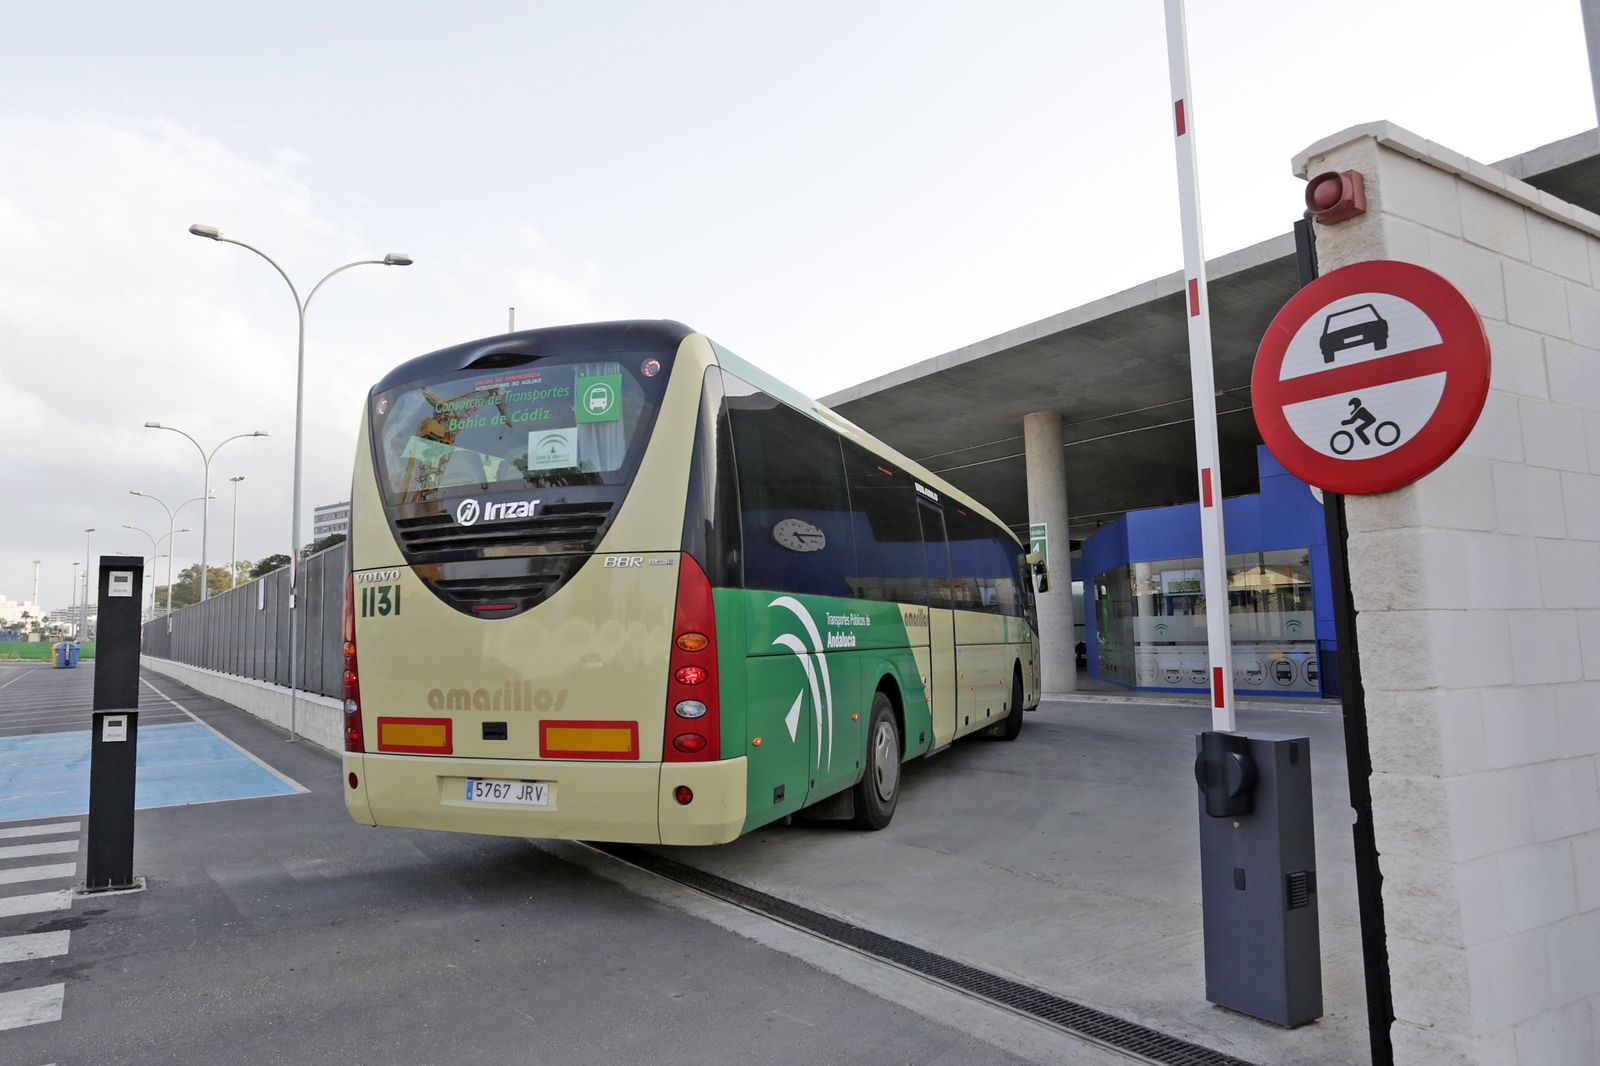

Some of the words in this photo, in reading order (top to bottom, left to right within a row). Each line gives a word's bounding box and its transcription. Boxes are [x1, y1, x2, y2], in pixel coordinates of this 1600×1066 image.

[434, 394, 485, 414] Consorcio
[487, 391, 501, 406] de
[504, 387, 570, 404] Transportes
[448, 414, 487, 432] Bahía
[491, 413, 507, 425] de
[511, 407, 552, 424] Cádiz
[355, 569, 402, 584] VOLVO
[361, 584, 401, 618] 1131
[825, 611, 850, 628] Transportes
[827, 631, 856, 648] Andalucía
[427, 680, 569, 712] amarillos
[476, 781, 511, 800] 5767
[516, 785, 543, 802] JRV
